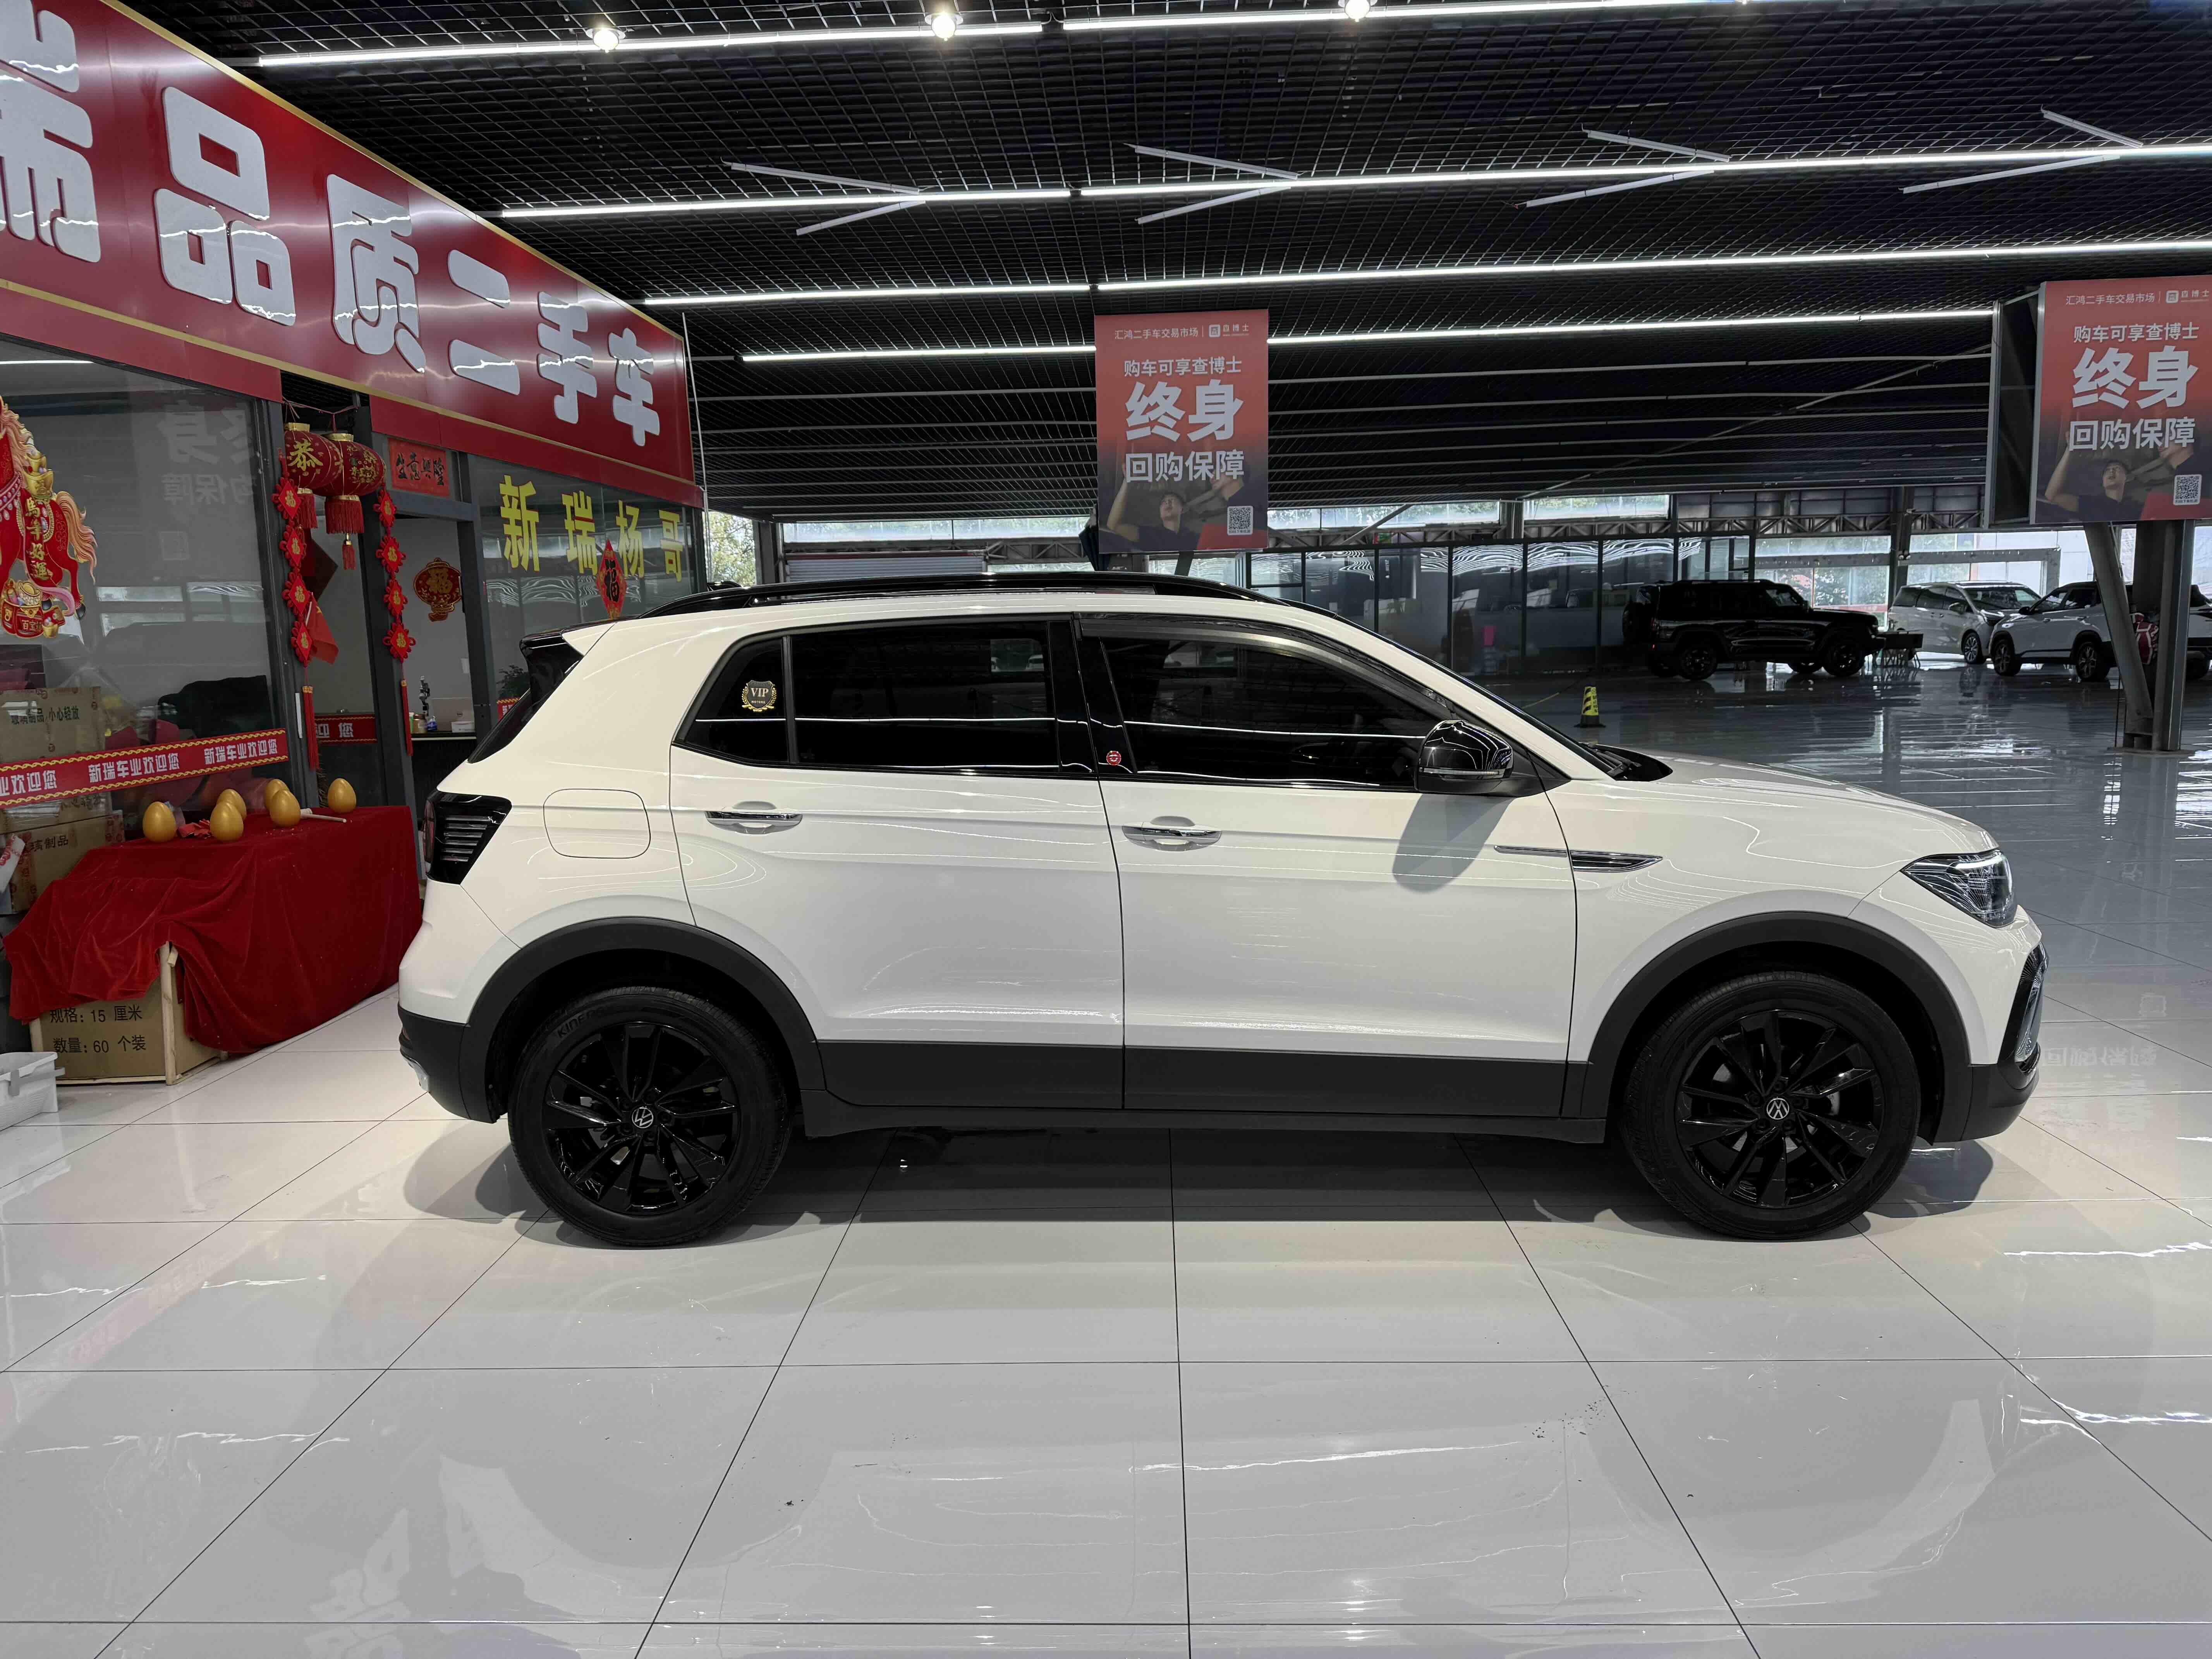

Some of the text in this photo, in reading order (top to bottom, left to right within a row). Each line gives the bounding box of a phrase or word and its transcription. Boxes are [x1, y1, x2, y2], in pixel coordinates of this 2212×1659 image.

[2073, 322, 2200, 343] 购车可享查博士
[1124, 356, 1242, 376] 购车可享查博士
[2073, 345, 2198, 409] 终身
[1125, 379, 1244, 442] 终身
[2068, 416, 2195, 451] 回购保障
[1125, 449, 1244, 483] 回购保障
[751, 687, 769, 697] VIP
[204, 738, 278, 765] 新瑞车业欢迎您
[88, 752, 180, 783] 新瑞车业欢迎您
